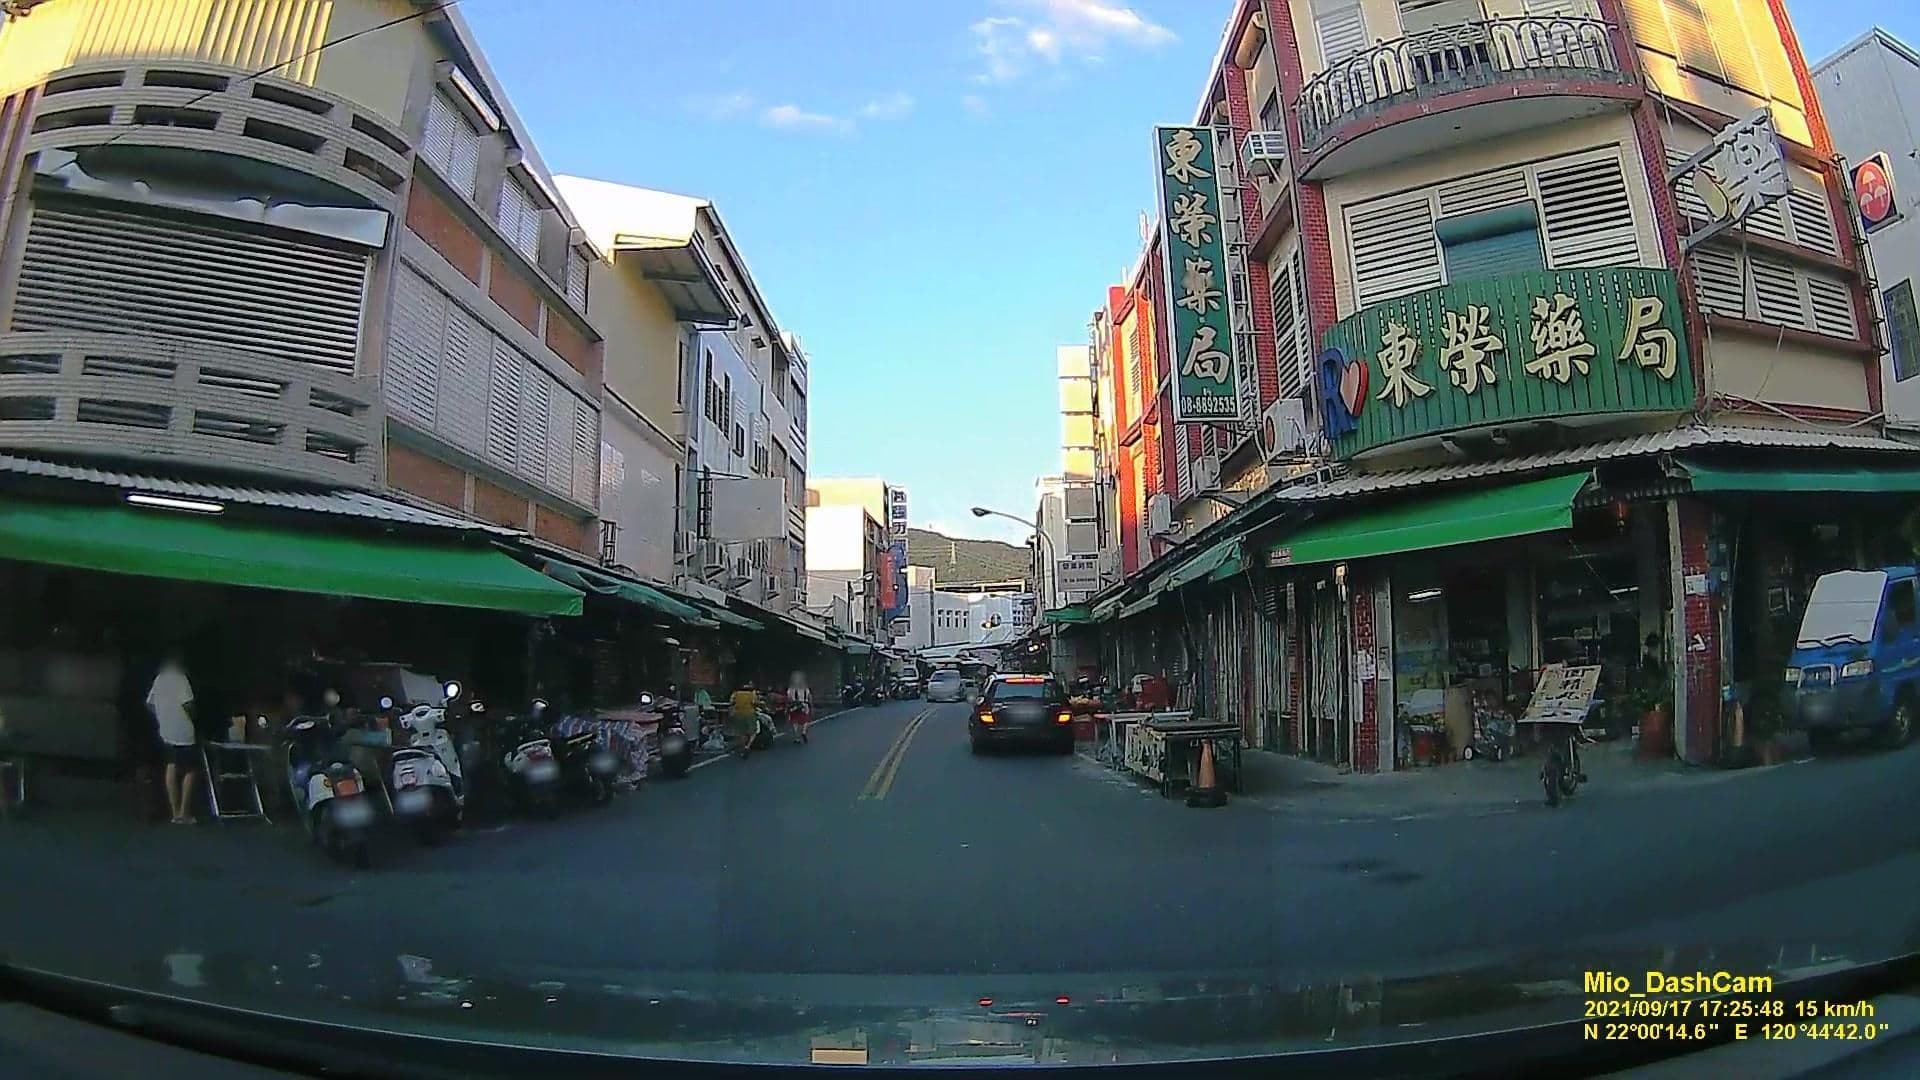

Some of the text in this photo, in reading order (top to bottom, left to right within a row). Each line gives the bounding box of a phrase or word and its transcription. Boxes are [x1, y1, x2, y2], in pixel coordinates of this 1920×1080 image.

[1375, 292, 1678, 409] 東榮藥局
[1180, 396, 1236, 414] 08-8892535
